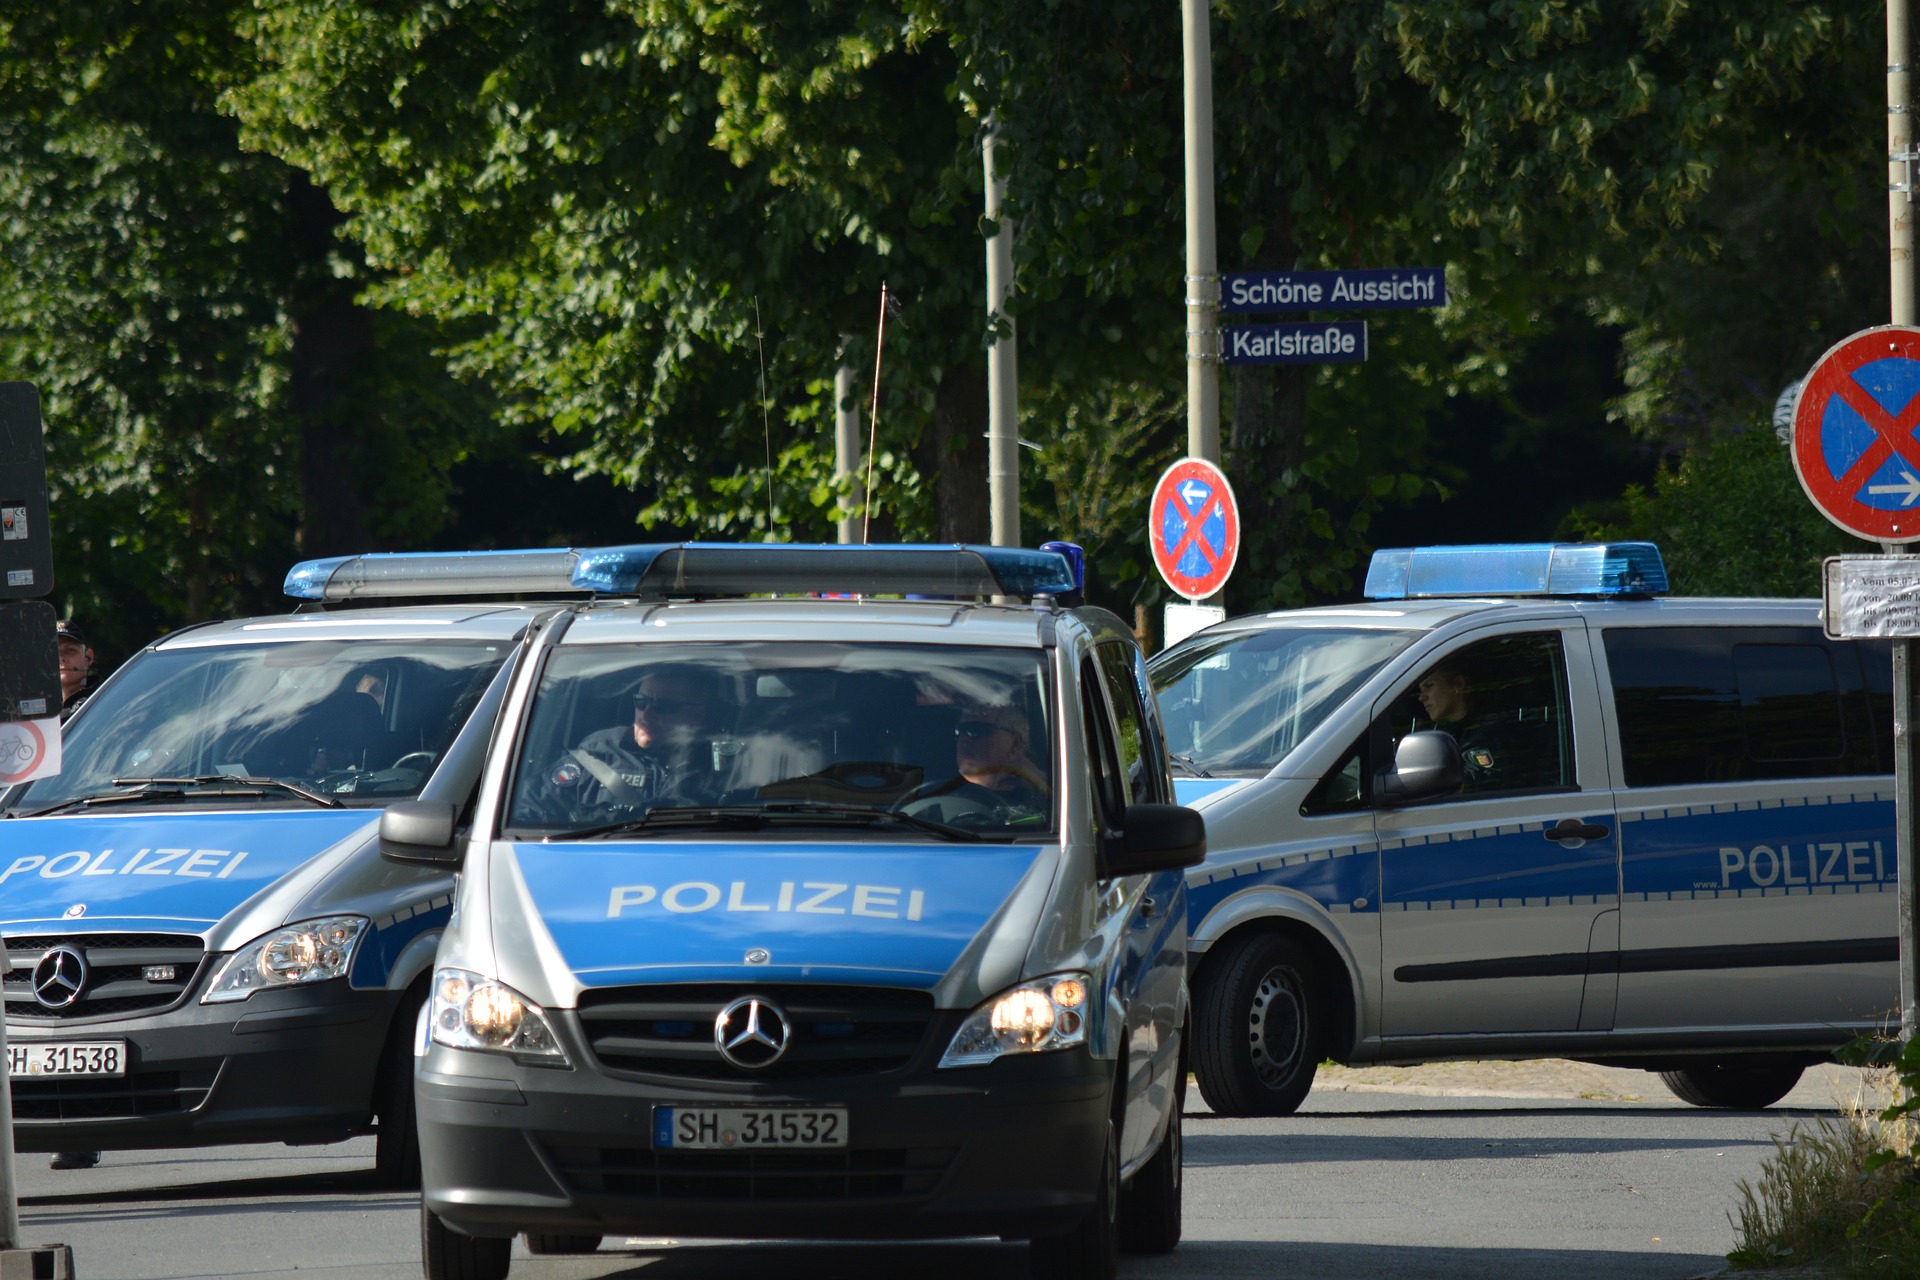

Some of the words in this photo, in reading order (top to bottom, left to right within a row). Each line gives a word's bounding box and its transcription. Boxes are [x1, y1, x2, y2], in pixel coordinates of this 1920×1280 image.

[1231, 277, 1323, 305] Schöne
[1330, 274, 1436, 303] Aussicht
[1233, 327, 1356, 357] Karlstraße
[1861, 577, 1885, 586] Vom
[1886, 619, 1912, 628] 18.00
[0, 848, 249, 884] POLIZEI
[606, 881, 924, 921] POLIZEI
[43, 1047, 118, 1073] 31538
[678, 1112, 718, 1143] SH
[740, 1112, 839, 1143] 31532
